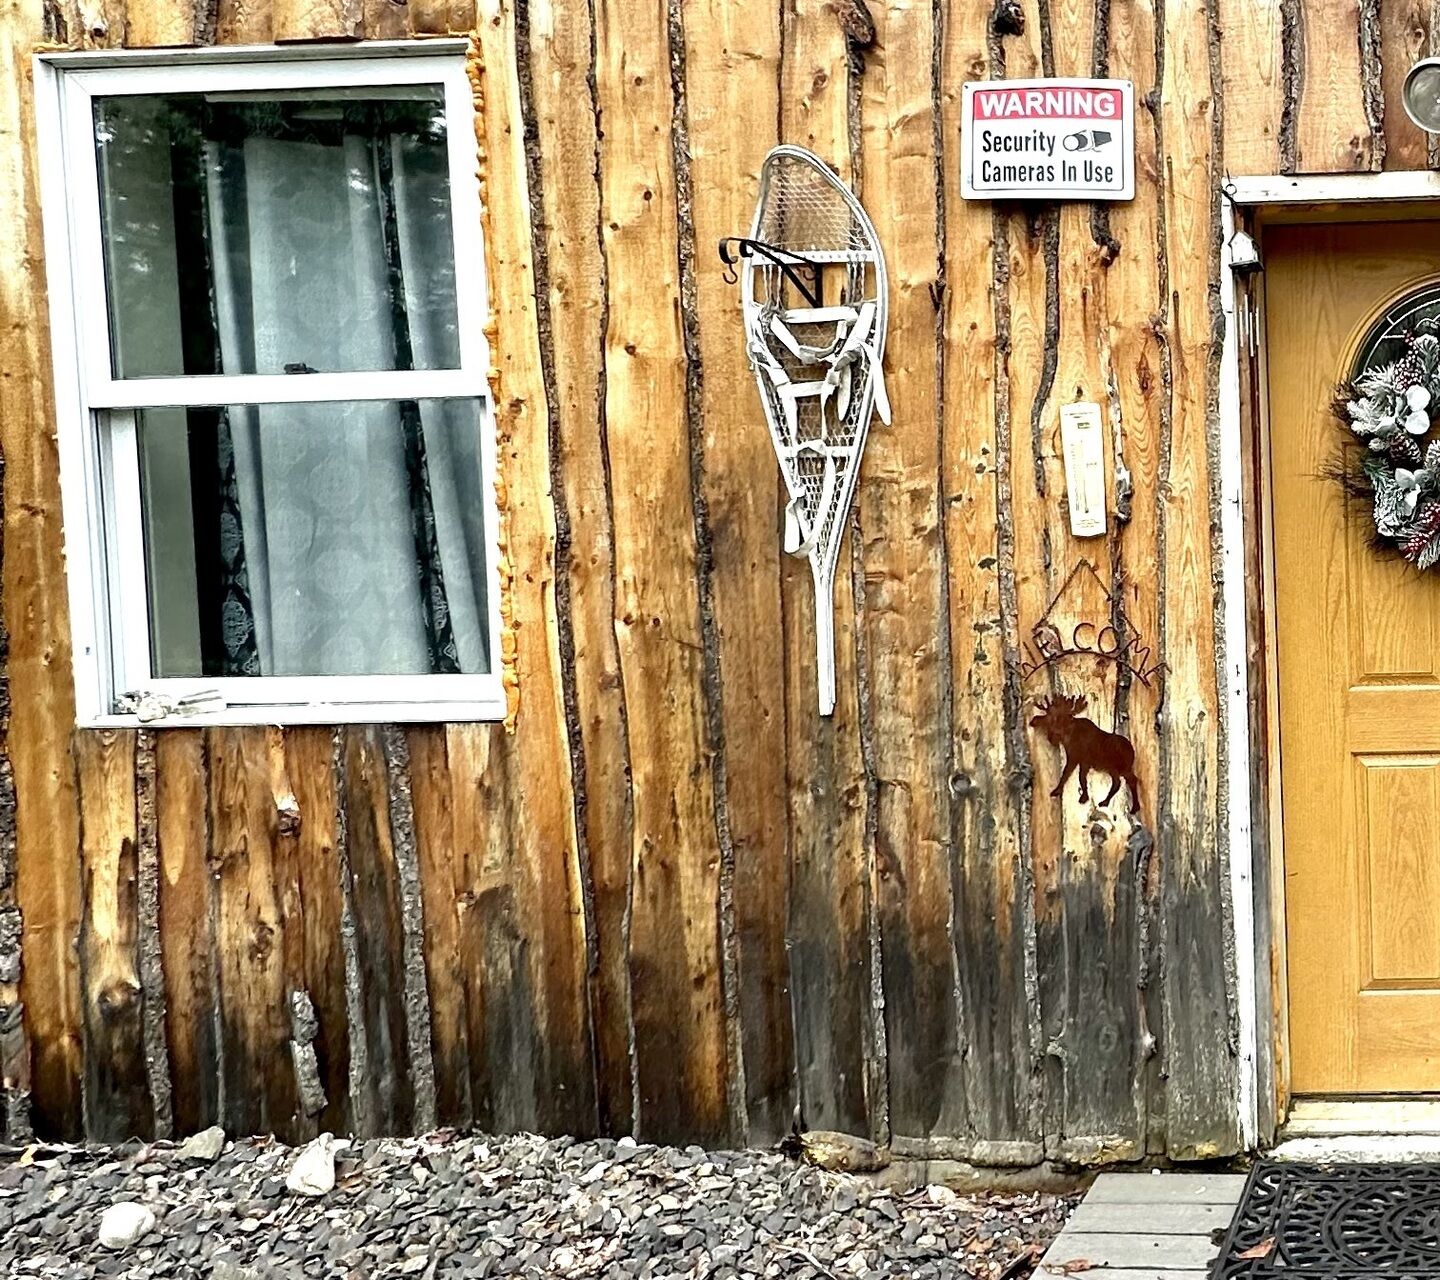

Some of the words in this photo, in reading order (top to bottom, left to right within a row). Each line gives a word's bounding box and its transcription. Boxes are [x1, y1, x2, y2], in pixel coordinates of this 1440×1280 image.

[980, 91, 1115, 117] WARNING
[982, 130, 1056, 157] Security
[982, 160, 1055, 183] Cameras
[1062, 160, 1077, 182] In
[1084, 160, 1113, 183] Use
[1004, 622, 1172, 687] WELCOME
